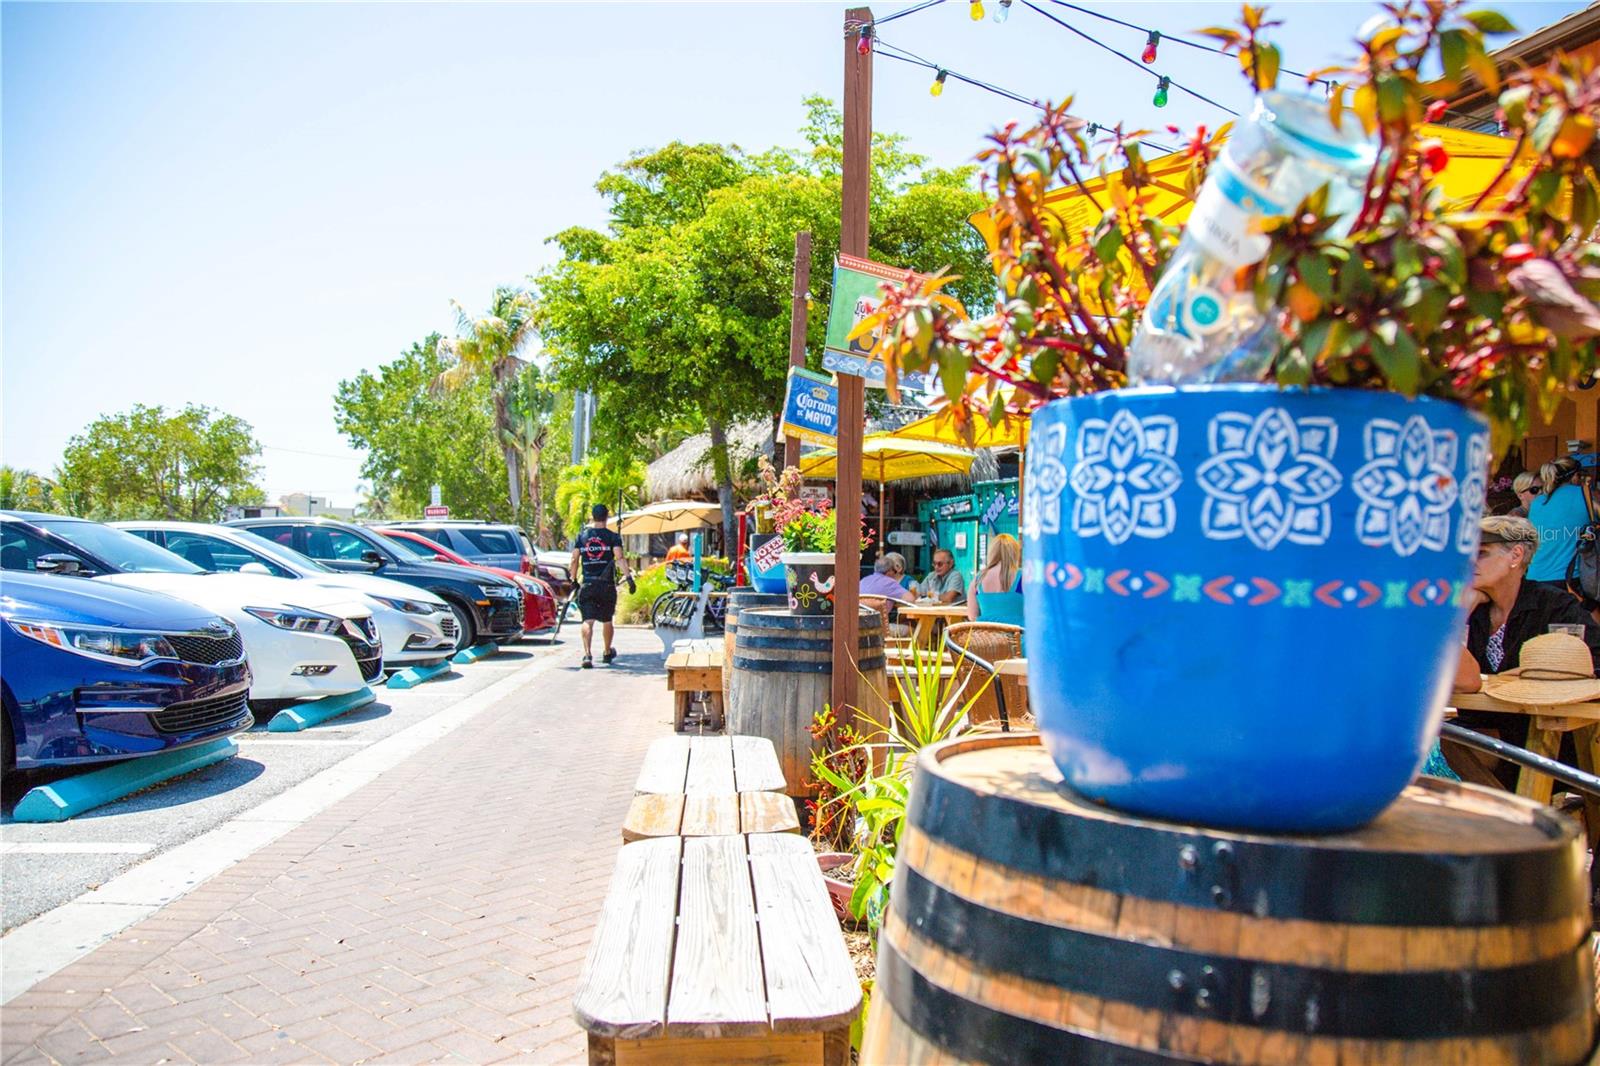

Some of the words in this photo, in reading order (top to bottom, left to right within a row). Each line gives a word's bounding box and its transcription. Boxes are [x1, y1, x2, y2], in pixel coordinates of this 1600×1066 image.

[797, 393, 837, 416] Corona
[805, 409, 832, 427] MAYO
[754, 536, 783, 558] VOTED
